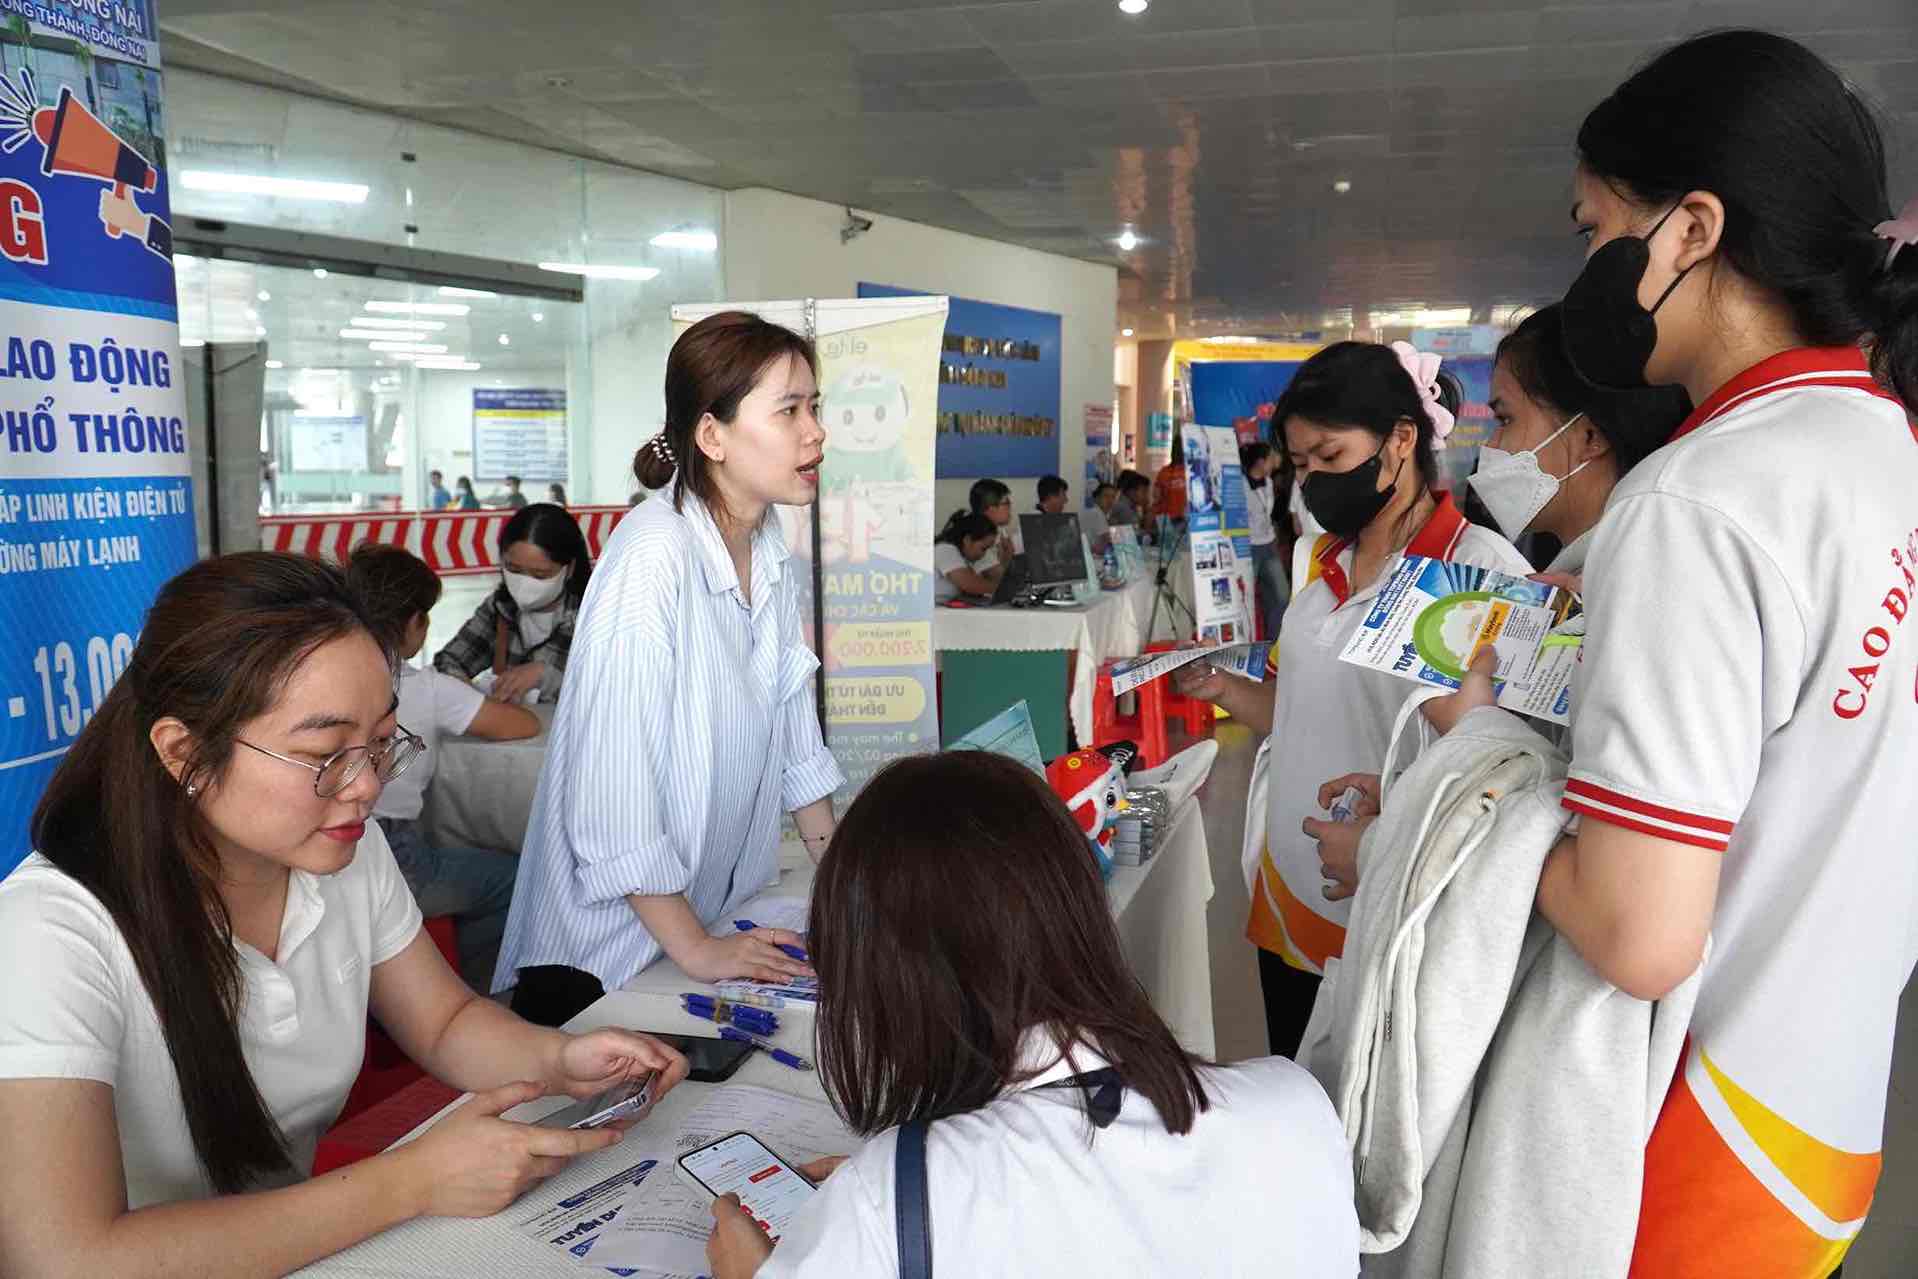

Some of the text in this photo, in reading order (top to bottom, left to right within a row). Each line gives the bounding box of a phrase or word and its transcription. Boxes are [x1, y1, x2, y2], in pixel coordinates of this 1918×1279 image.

[70, 338, 170, 393] ĐỘNG
[68, 407, 185, 454] THÔNG
[26, 493, 70, 522] LINH
[73, 487, 122, 524] KIỆN
[126, 485, 167, 521] ĐIỆN
[168, 481, 187, 514] TỬ
[40, 534, 80, 569] MÁY
[87, 535, 141, 571] LẠNH
[1833, 626, 1890, 719] CAO
